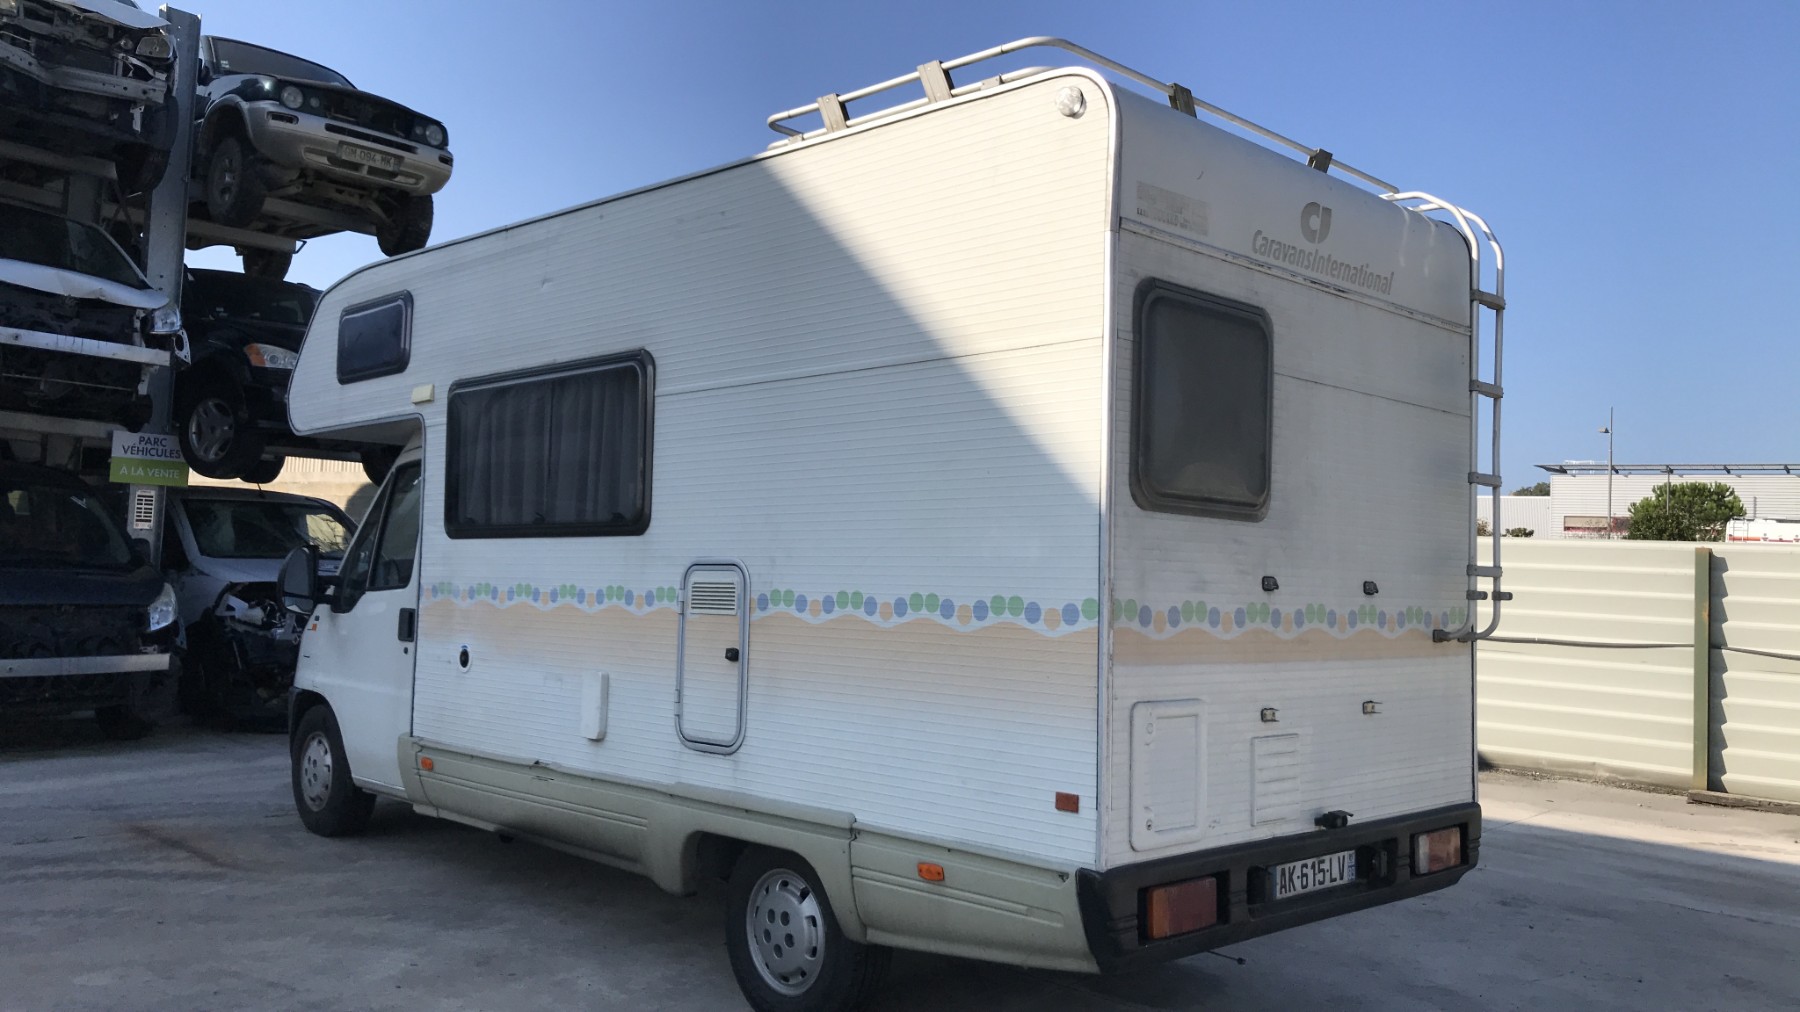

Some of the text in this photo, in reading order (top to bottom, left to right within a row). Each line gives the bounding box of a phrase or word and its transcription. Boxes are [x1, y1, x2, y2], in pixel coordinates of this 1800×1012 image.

[138, 436, 167, 447] PARC
[122, 443, 181, 458] VÉHICULES
[131, 466, 144, 476] LA
[147, 468, 180, 478] VENTE
